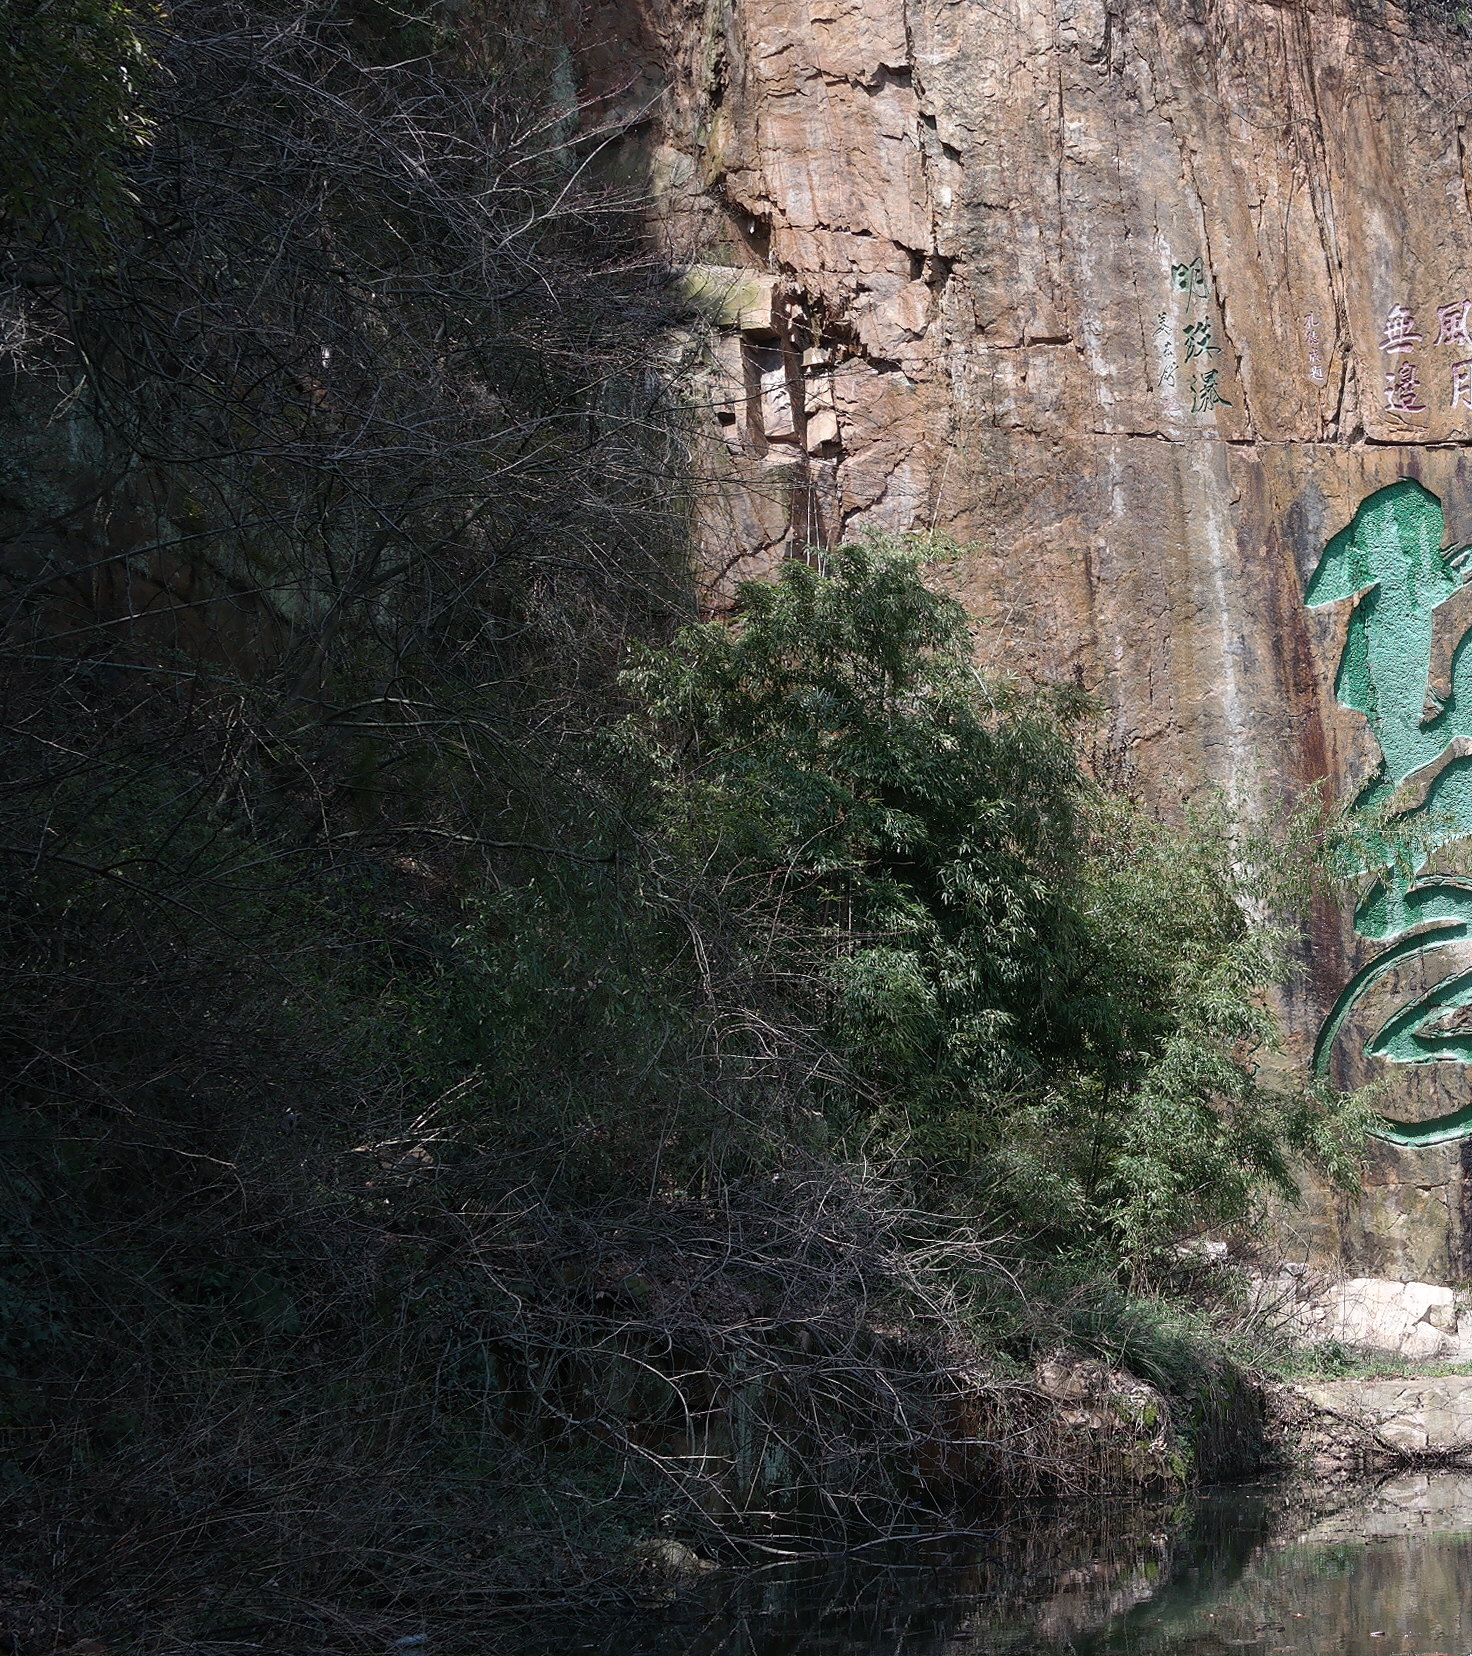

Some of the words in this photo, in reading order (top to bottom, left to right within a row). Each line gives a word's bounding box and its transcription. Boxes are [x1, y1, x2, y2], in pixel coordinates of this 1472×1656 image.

[1171, 257, 1233, 413] 明珠瀑
[1379, 302, 1427, 413] 無邊
